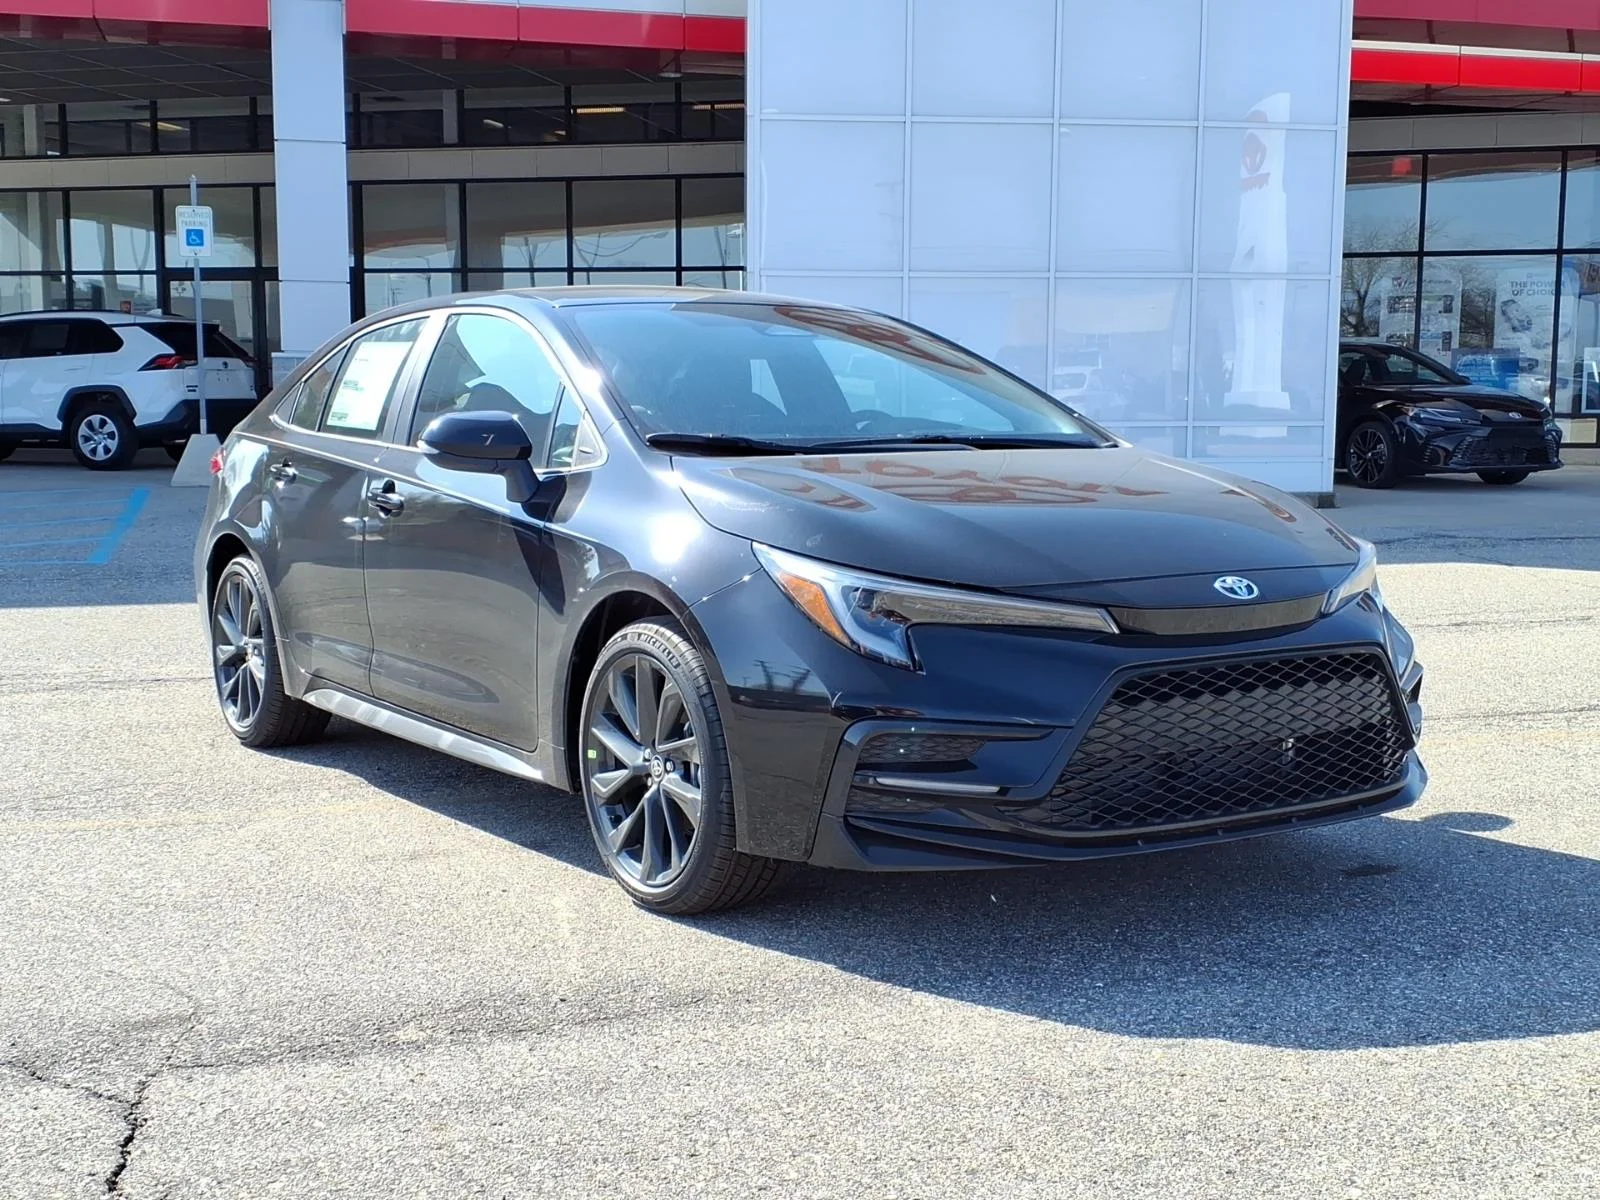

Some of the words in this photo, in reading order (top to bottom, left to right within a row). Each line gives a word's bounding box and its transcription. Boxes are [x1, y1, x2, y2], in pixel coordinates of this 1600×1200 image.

[181, 220, 209, 228] PARKING
[1510, 280, 1528, 288] THE
[1511, 288, 1525, 296] OF
[1527, 288, 1556, 297] CHOIC
[639, 633, 681, 669] MICHELIN
